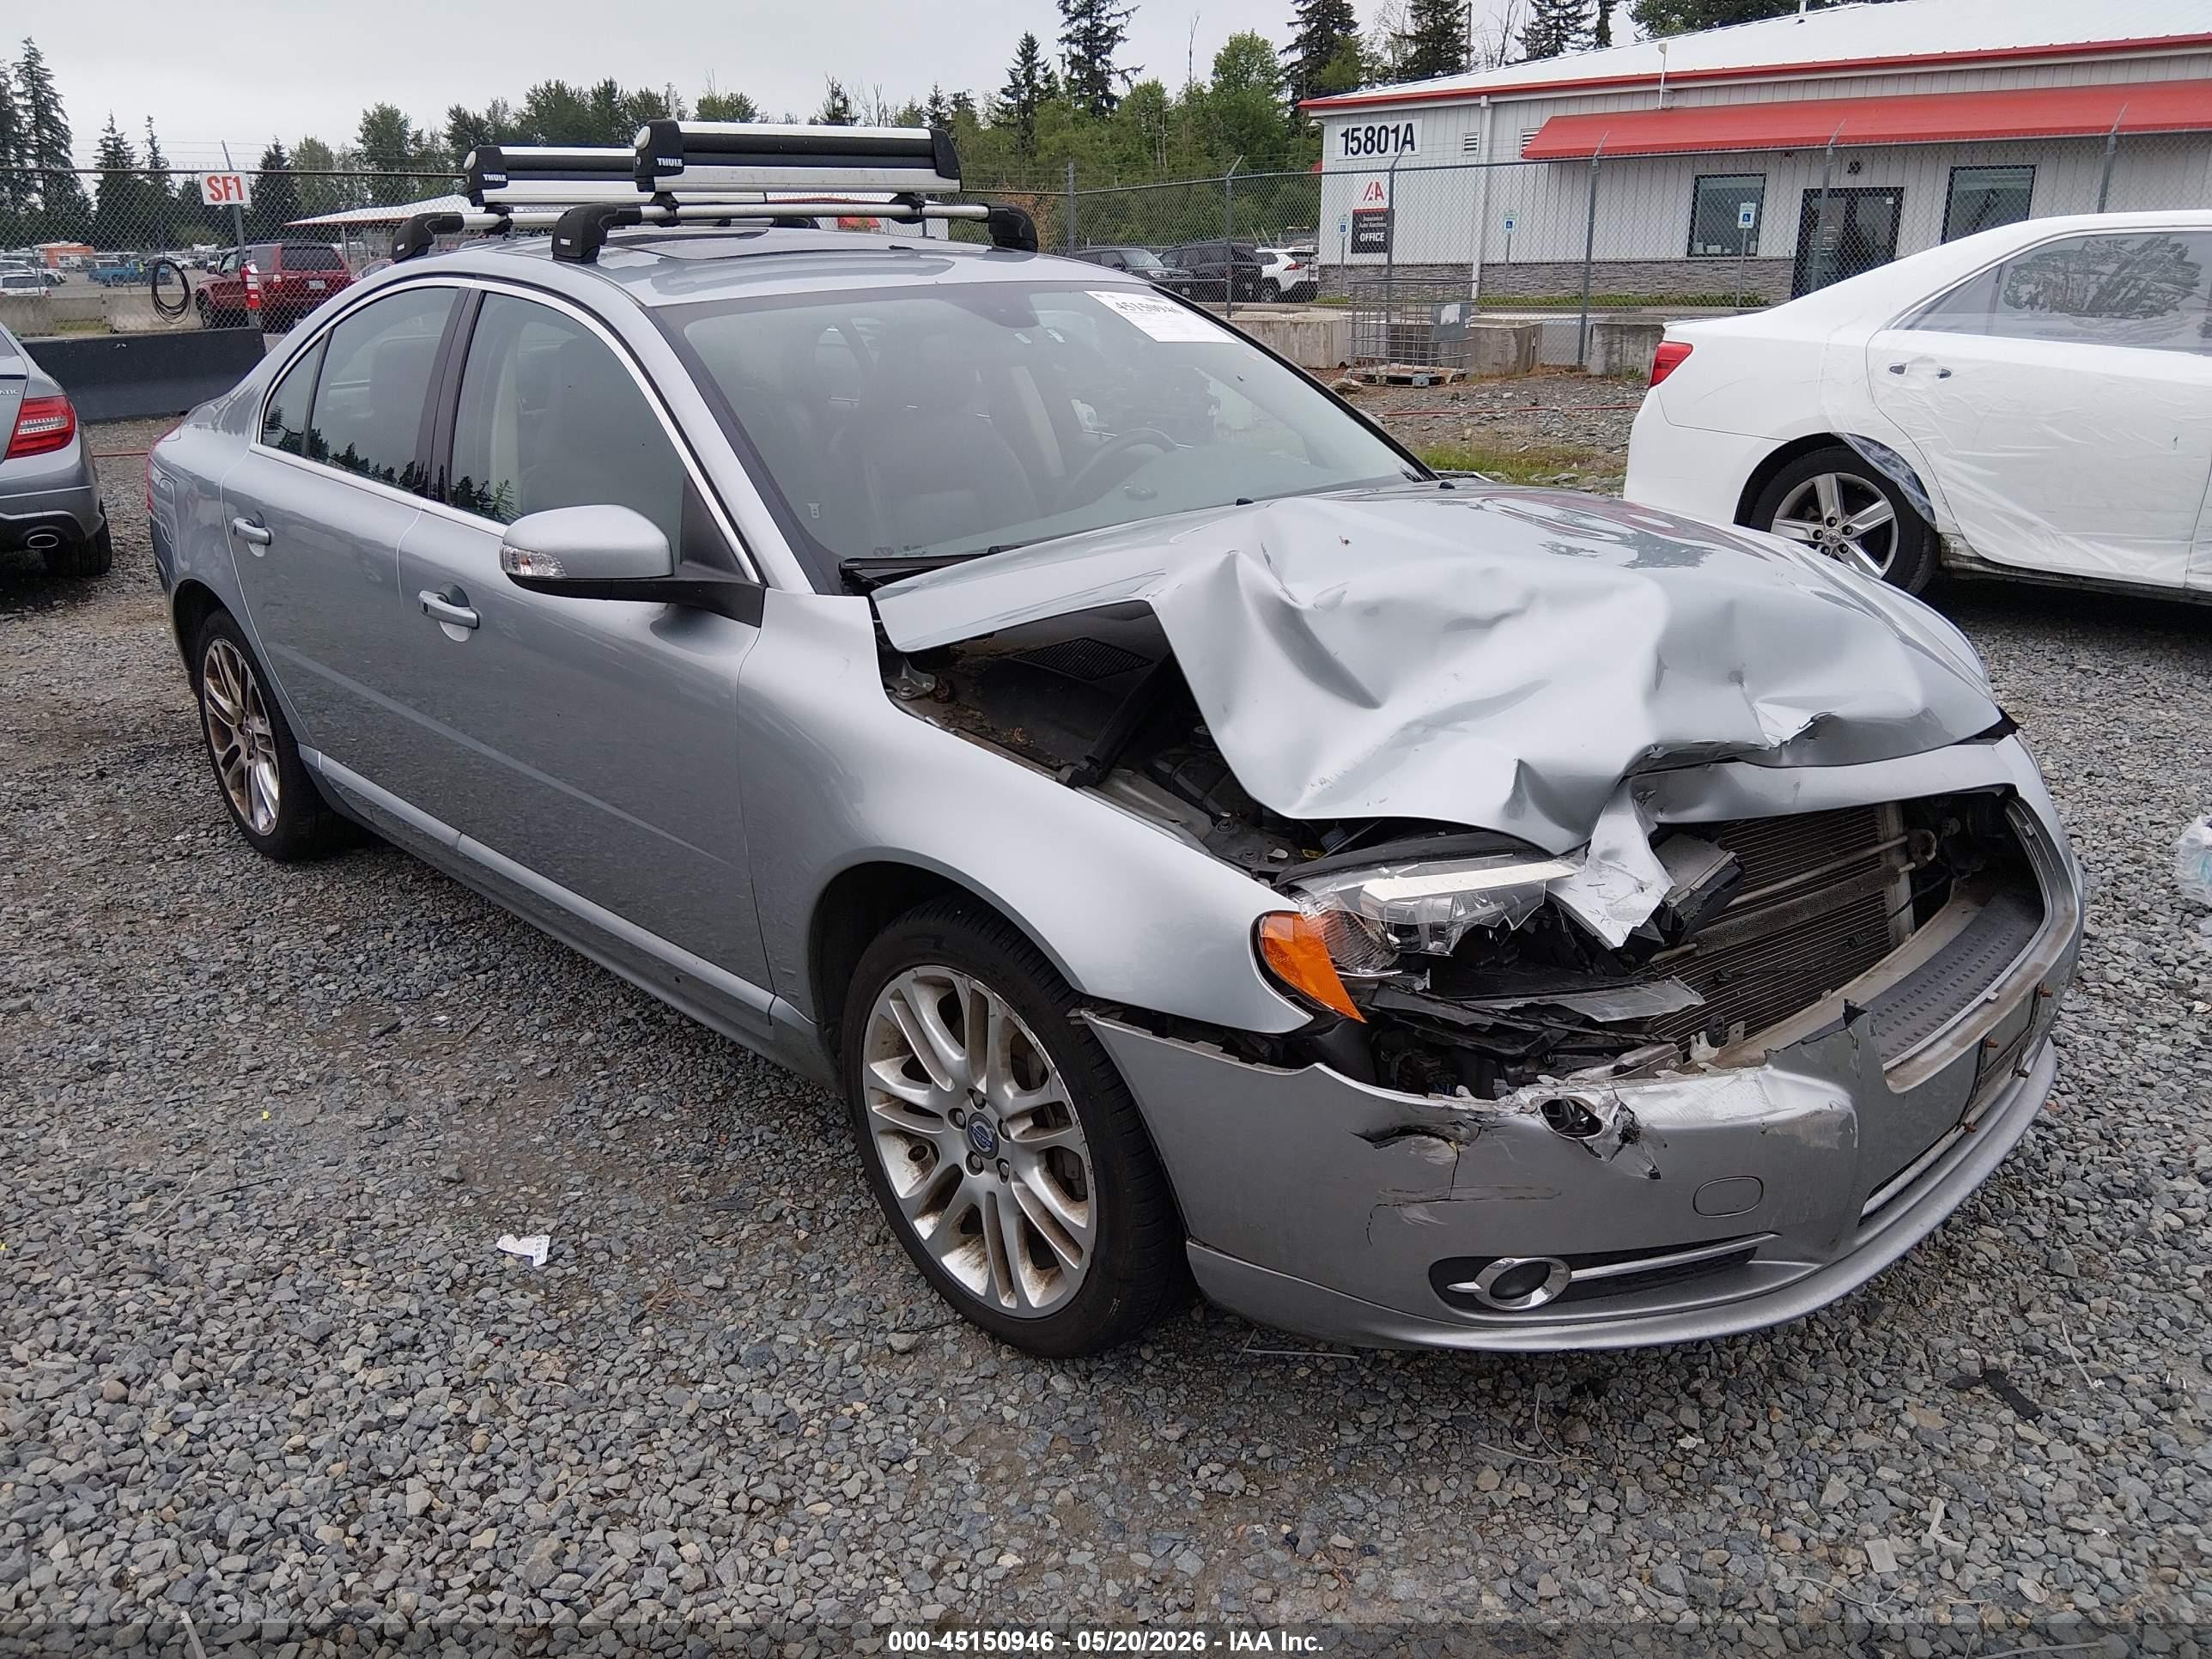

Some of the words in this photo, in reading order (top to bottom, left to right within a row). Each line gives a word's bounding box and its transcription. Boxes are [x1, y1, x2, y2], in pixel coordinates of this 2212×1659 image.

[1340, 123, 1415, 155] 15801A
[657, 158, 683, 167] THULE
[207, 176, 244, 201] SF1
[1359, 233, 1385, 242] OFFICE
